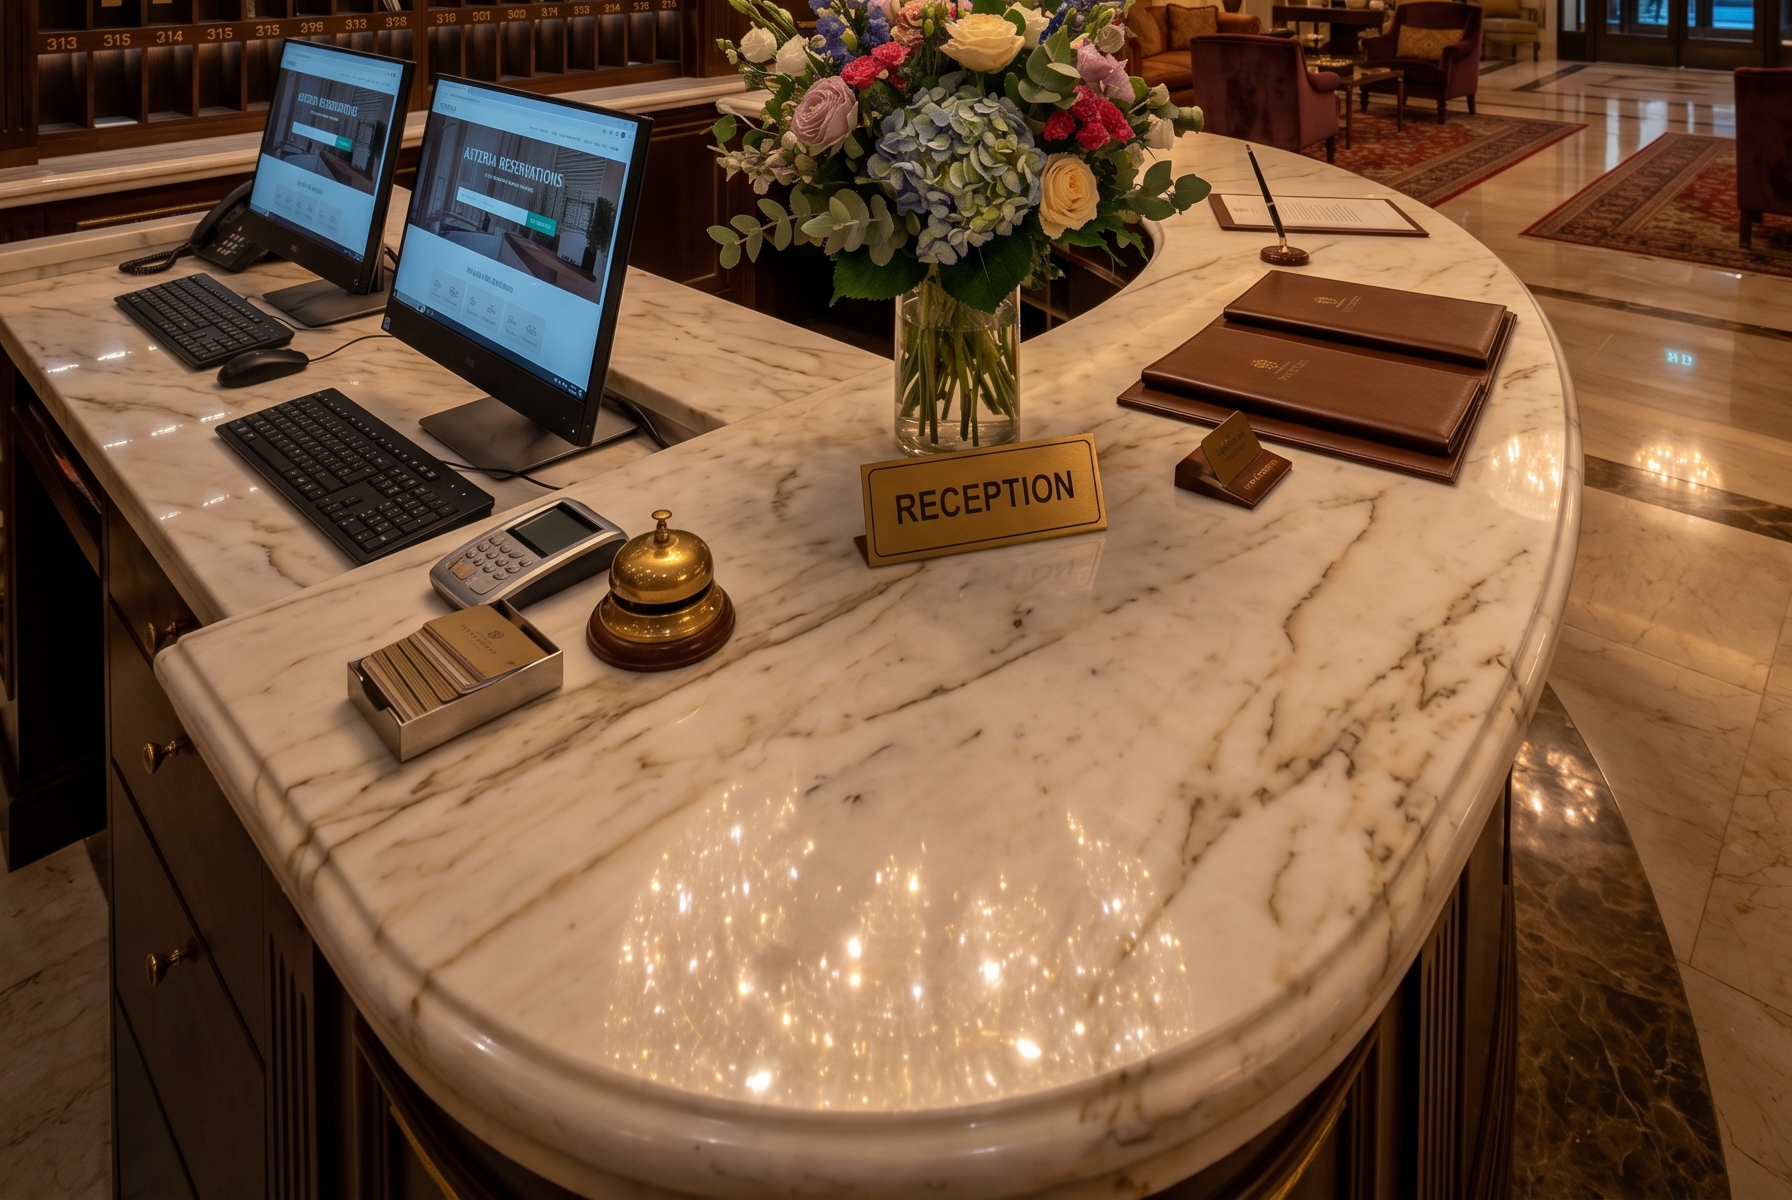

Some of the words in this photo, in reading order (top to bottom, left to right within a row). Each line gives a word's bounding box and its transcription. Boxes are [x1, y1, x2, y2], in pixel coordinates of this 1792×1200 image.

[47, 37, 77, 51] 313
[103, 34, 131, 47] 315
[156, 30, 183, 44] 314
[463, 146, 497, 168] ASTERIA
[895, 469, 1075, 525] RECEPTION
